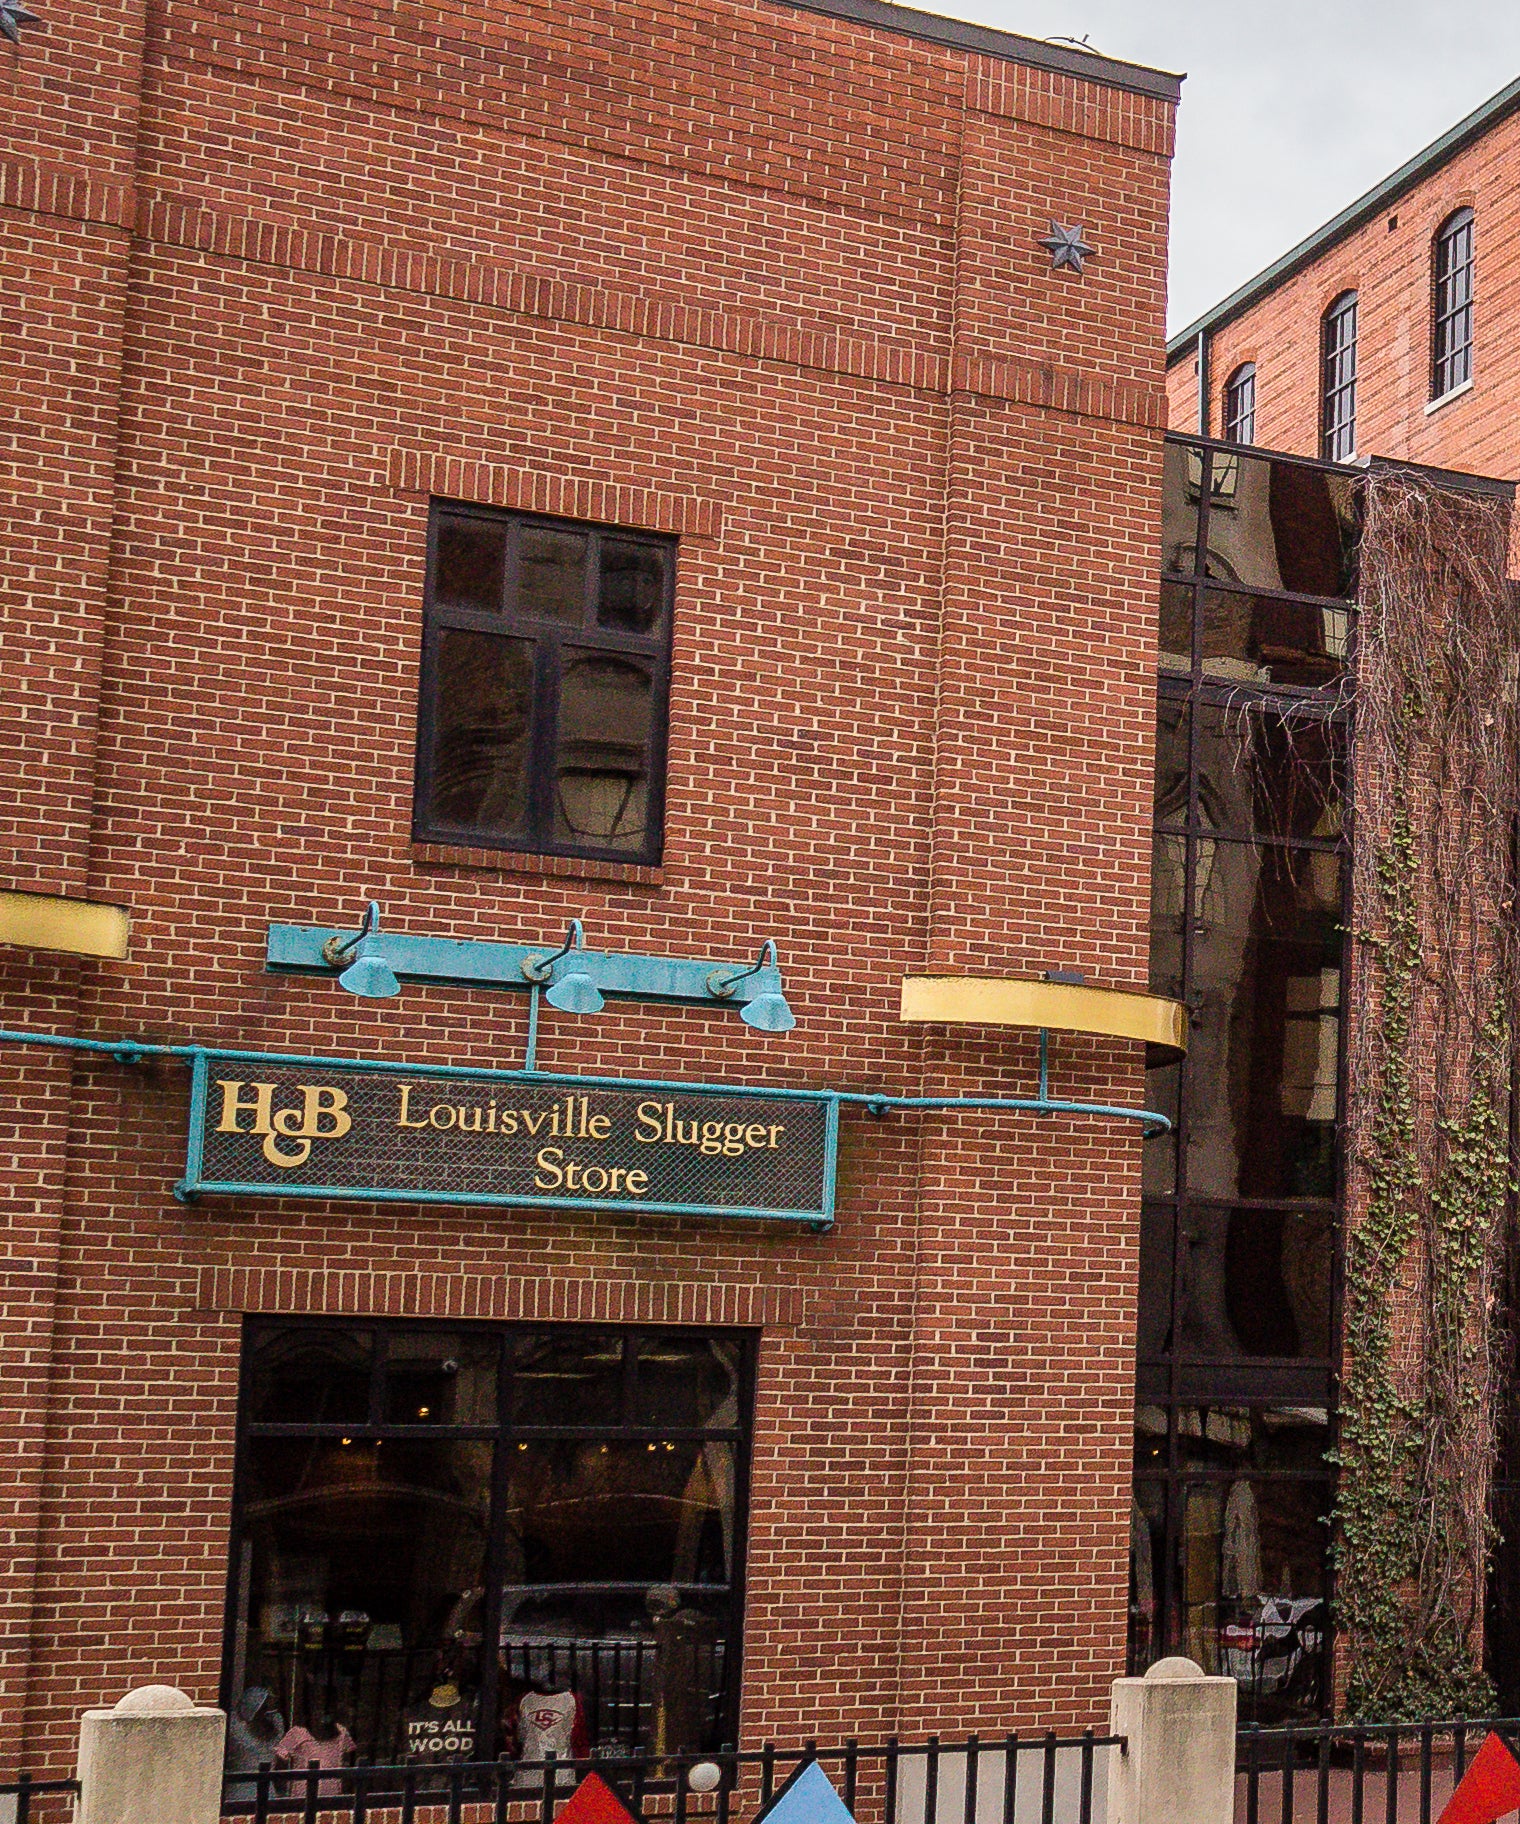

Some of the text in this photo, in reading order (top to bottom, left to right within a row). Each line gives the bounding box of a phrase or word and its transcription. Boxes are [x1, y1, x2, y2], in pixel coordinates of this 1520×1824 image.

[216, 1079, 785, 1167] H&B Louisville Slugger
[534, 1147, 649, 1194] Store
[408, 1719, 476, 1735] IT'S ALL
[408, 1737, 473, 1752] WOOD
